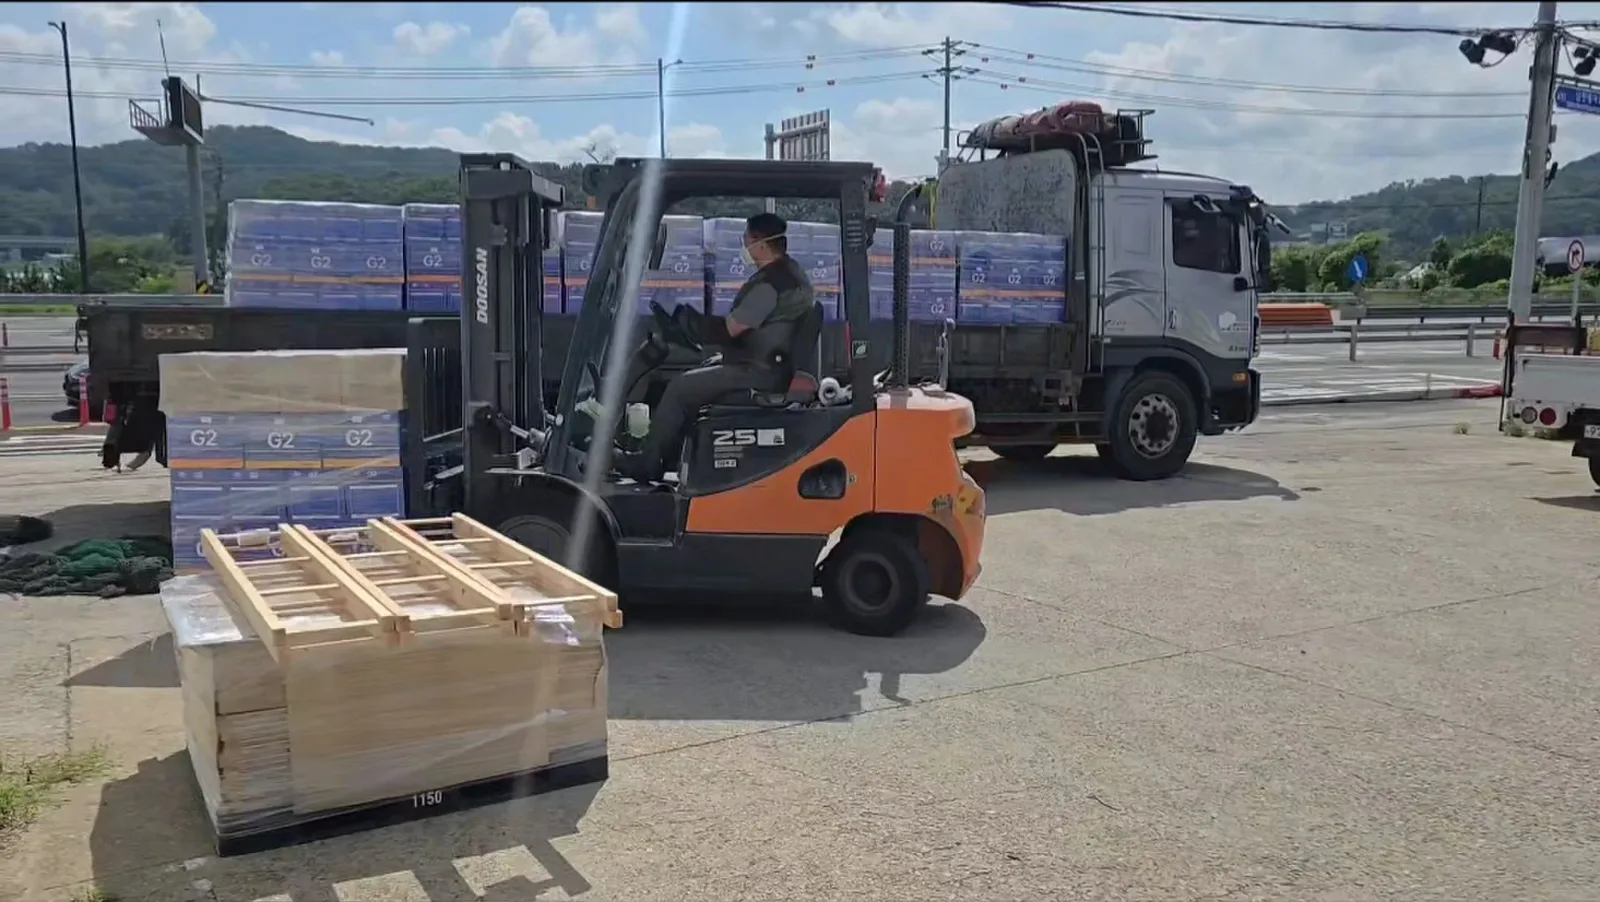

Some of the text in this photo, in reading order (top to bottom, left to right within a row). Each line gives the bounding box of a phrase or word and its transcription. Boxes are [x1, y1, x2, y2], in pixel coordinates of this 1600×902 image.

[251, 253, 272, 267] G2
[310, 255, 332, 269] G2
[366, 256, 387, 269] G2
[423, 254, 443, 267] G2
[674, 261, 690, 274] G2
[476, 247, 488, 324] DOOSAN
[190, 429, 218, 446] G2
[267, 431, 295, 449] G2
[345, 429, 373, 446] G2
[712, 429, 756, 445] 25
[412, 790, 443, 808] 1150
